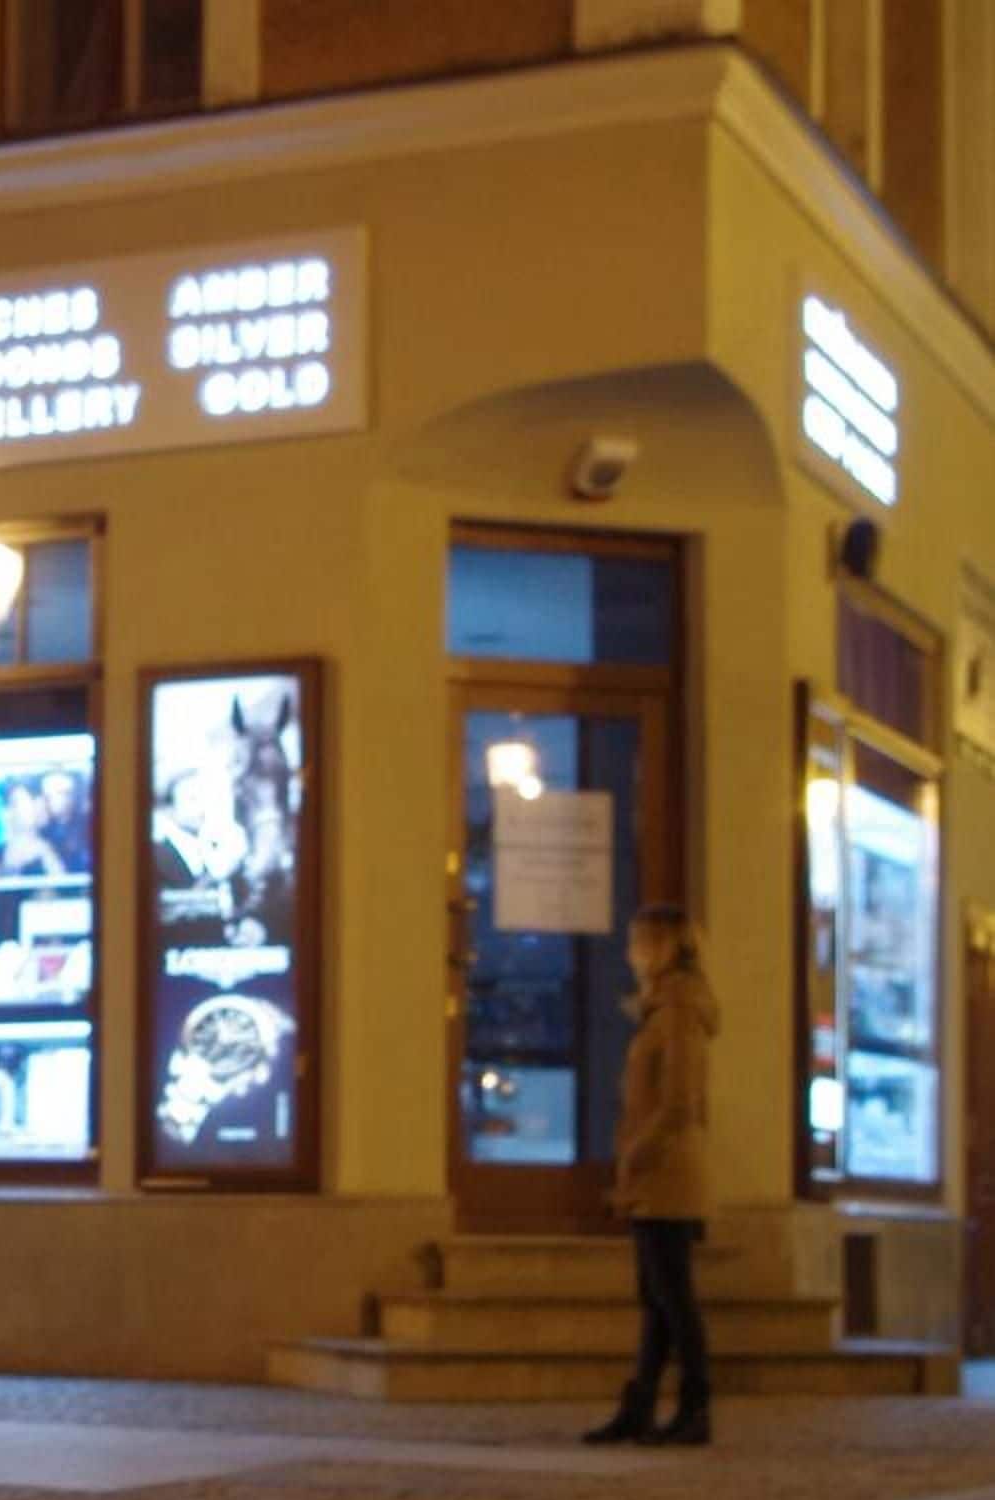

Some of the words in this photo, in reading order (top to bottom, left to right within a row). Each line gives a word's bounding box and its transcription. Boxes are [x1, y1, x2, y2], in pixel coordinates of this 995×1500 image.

[170, 258, 329, 318] AMBER
[169, 310, 329, 370] SILVER
[200, 362, 329, 416] GOLD
